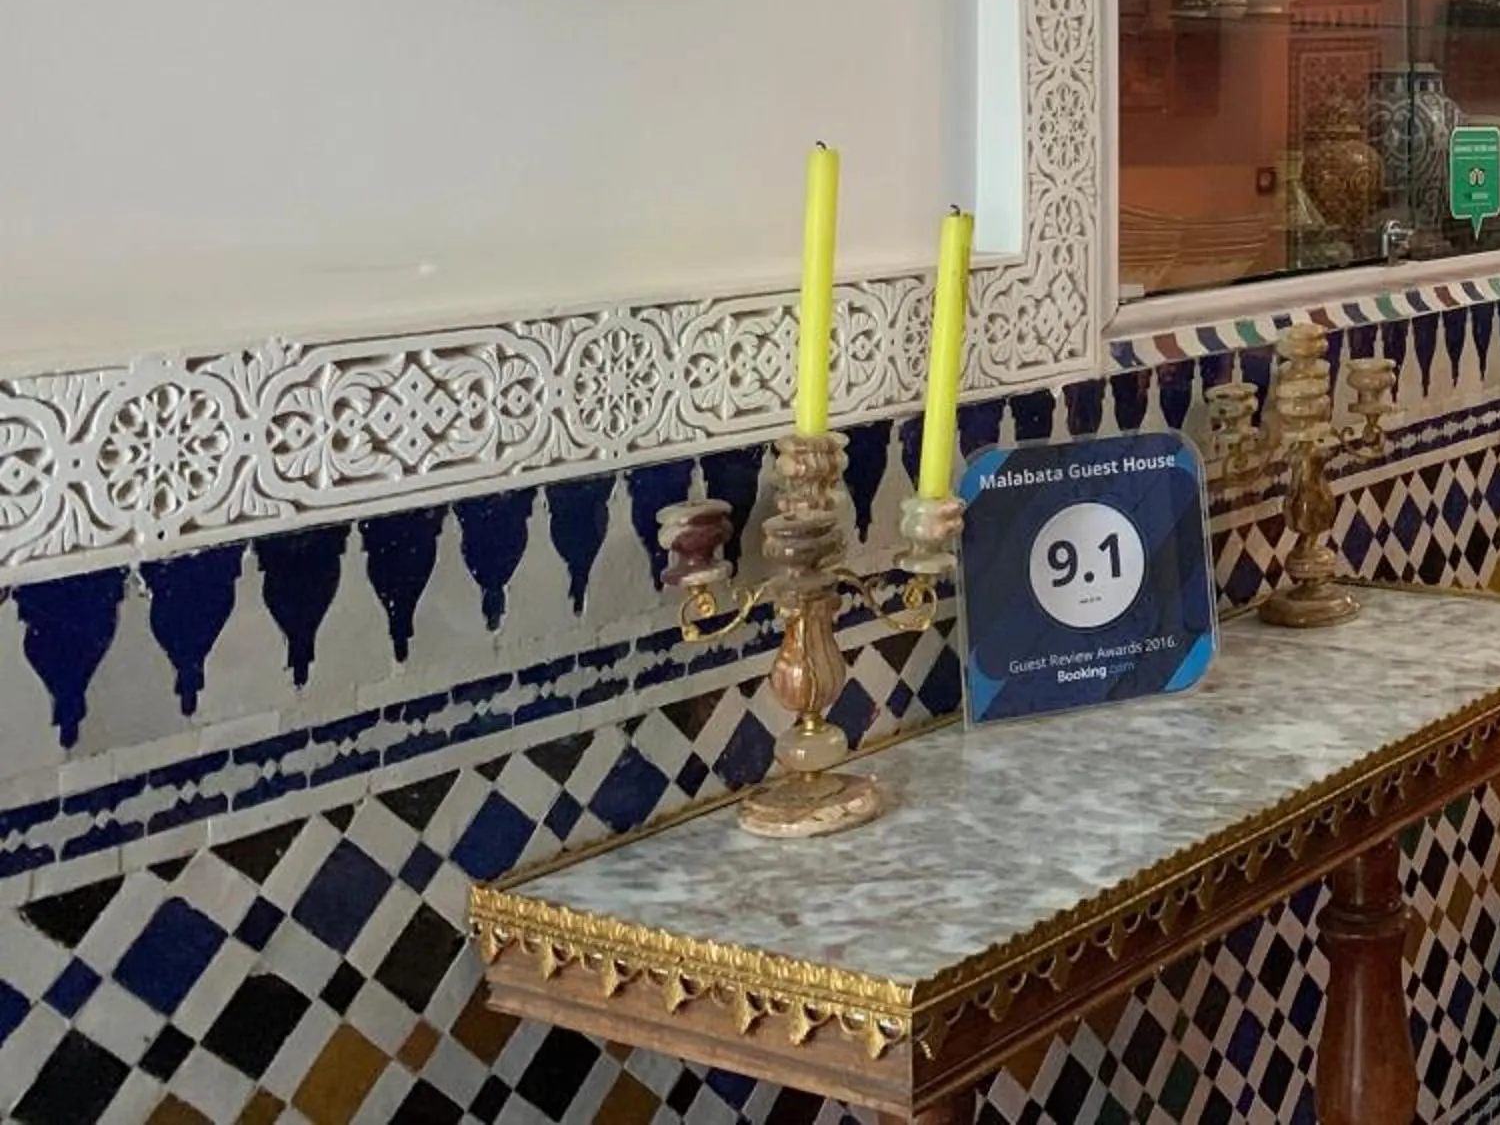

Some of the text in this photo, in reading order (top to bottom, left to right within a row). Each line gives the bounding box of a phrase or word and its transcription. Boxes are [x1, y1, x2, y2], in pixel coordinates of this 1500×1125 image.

[979, 454, 1176, 490] Malabata Guest House
[1047, 533, 1121, 588] 9.1
[1009, 635, 1175, 674] Guest Review Awards 2016
